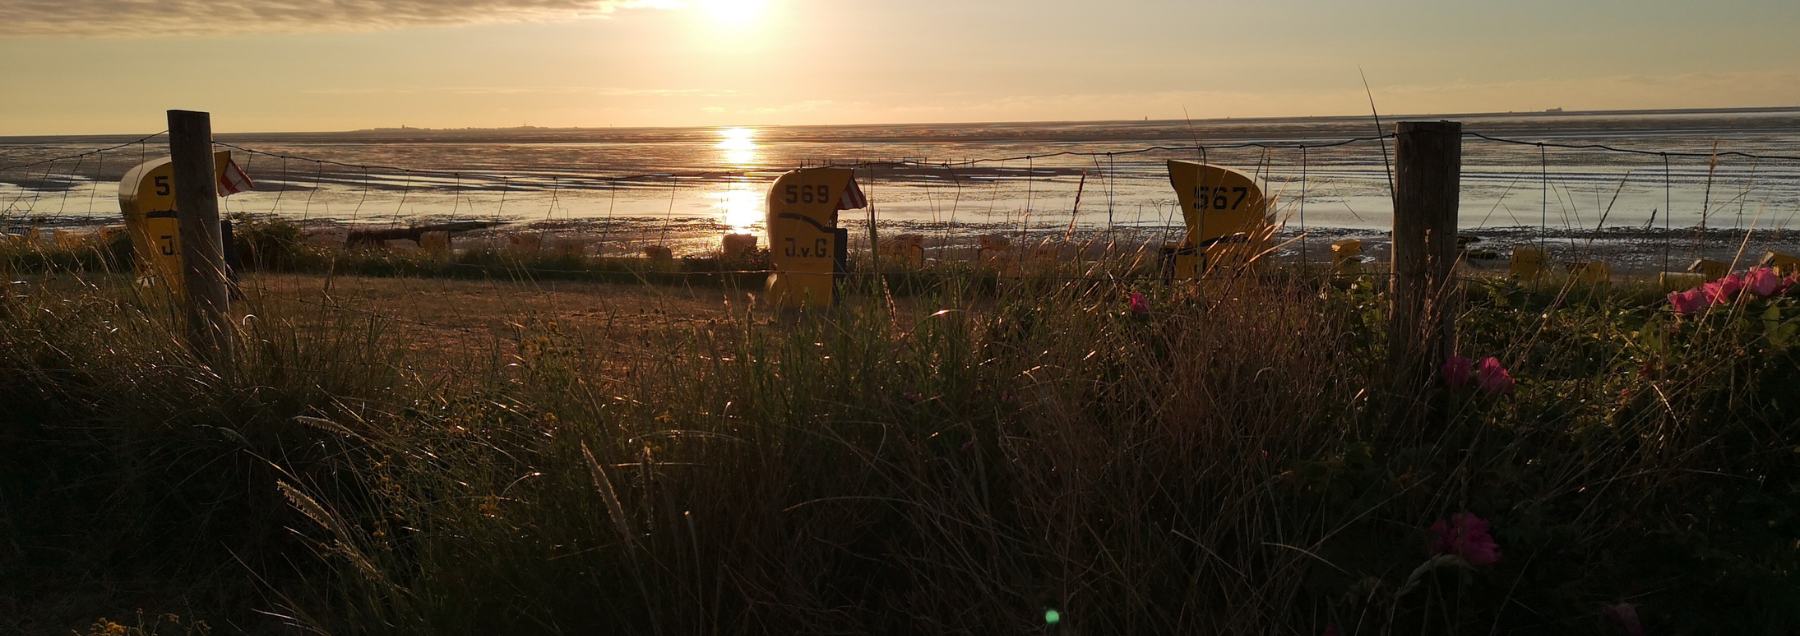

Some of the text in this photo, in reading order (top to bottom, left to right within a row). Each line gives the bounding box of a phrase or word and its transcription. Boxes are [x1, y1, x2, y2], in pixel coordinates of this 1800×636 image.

[785, 184, 830, 204] 569
[1193, 186, 1247, 210] 567
[785, 237, 832, 258] J.v.G.
